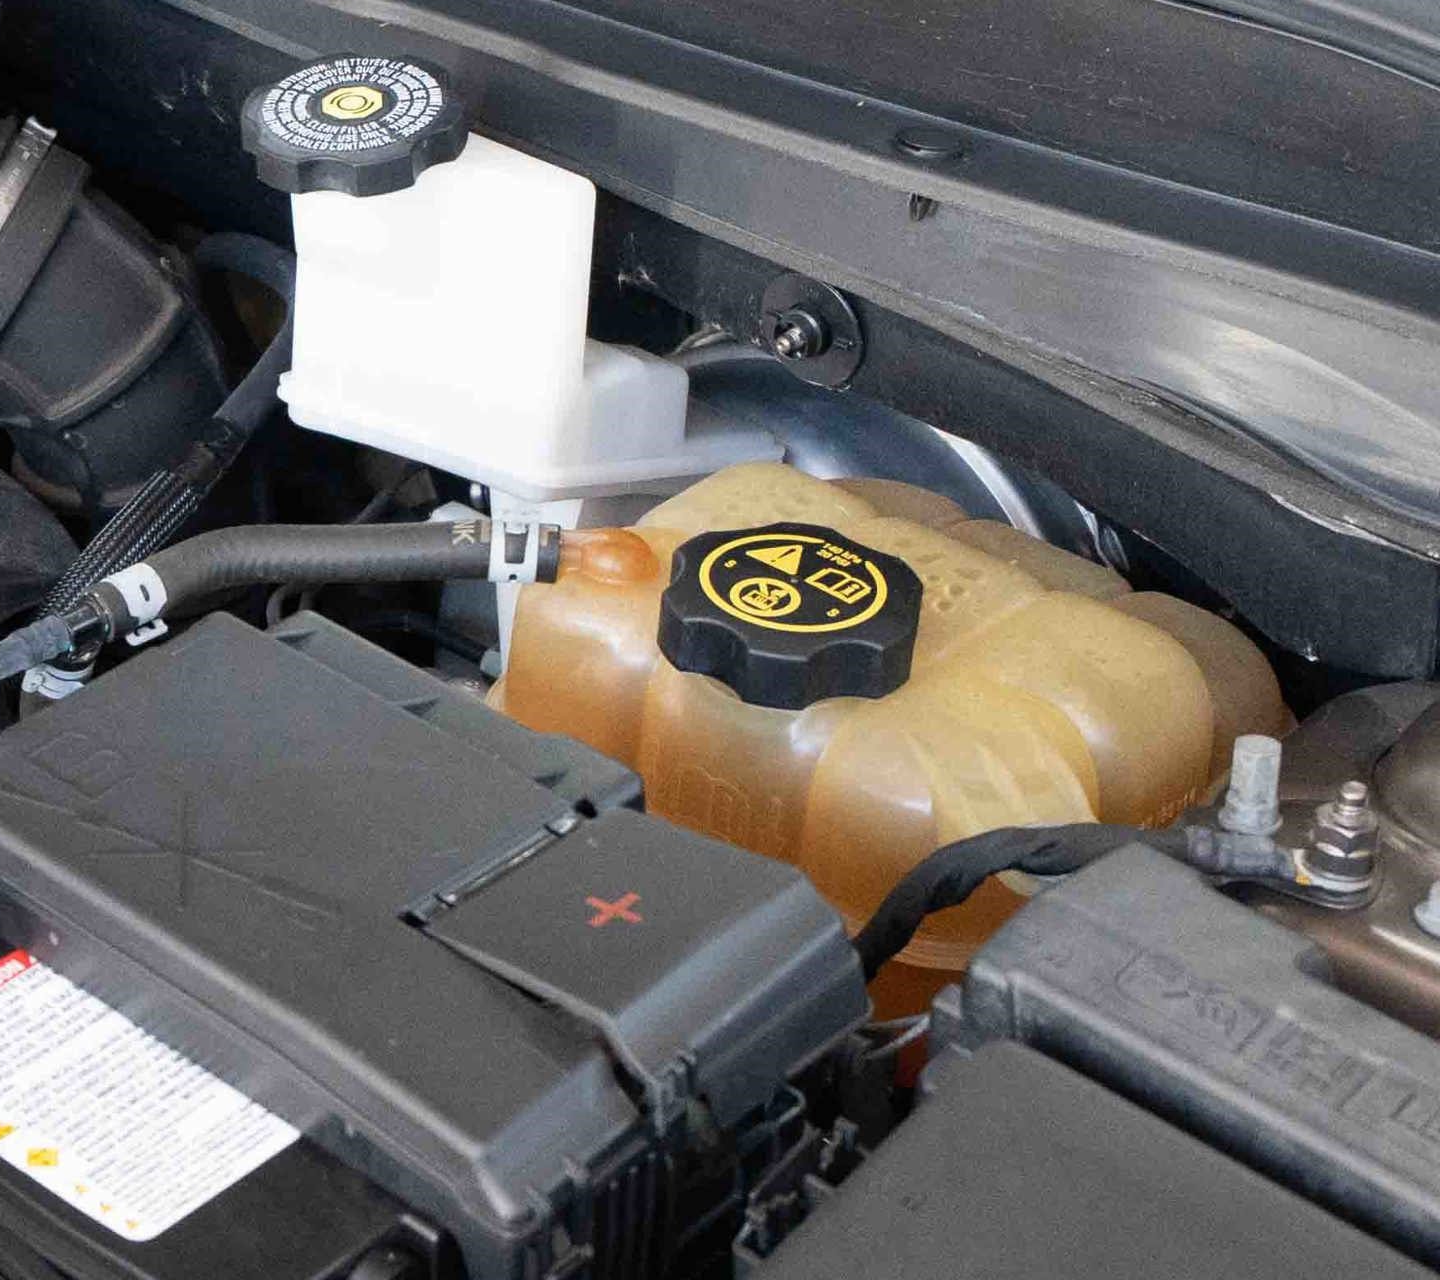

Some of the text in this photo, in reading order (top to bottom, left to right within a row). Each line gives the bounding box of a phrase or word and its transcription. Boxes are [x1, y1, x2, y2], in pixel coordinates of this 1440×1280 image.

[306, 74, 367, 93] PROVENANT
[306, 119, 379, 133] CLEAN FILLER
